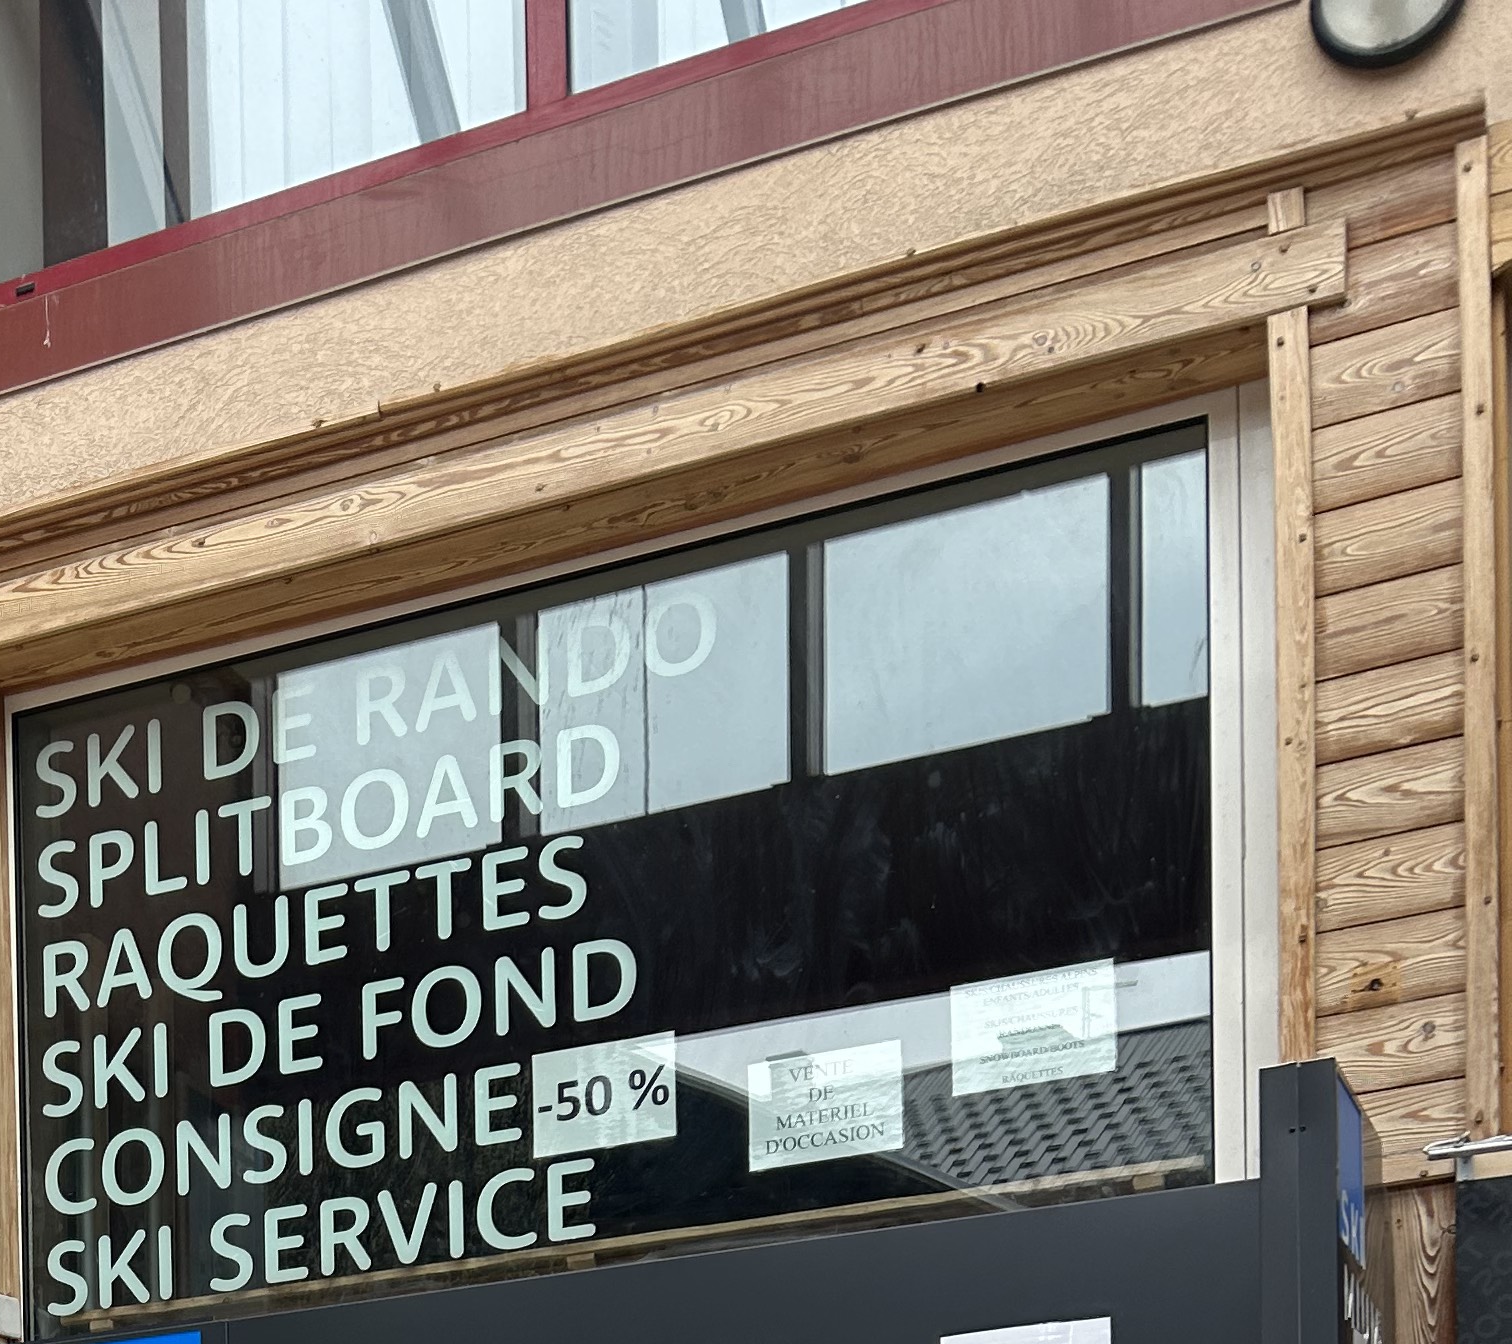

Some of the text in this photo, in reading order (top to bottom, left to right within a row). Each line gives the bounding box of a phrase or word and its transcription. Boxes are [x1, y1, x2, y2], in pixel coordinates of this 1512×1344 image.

[36, 597, 718, 819] SKI DE RANDO
[37, 723, 621, 918] SPLITBOARD
[44, 836, 587, 1018] RAQUETTES
[43, 938, 637, 1118] SKI DE FOND
[789, 1059, 854, 1082] VENTE
[1002, 1066, 1063, 1084] RAQUETTES
[45, 1063, 520, 1216] CONSIGNE
[538, 1064, 670, 1122] -50 %
[766, 1122, 885, 1155] D'OCCASION
[776, 1102, 874, 1130] MATERIEL
[809, 1085, 834, 1102] DE
[48, 1158, 596, 1317] SKI SERVICE
